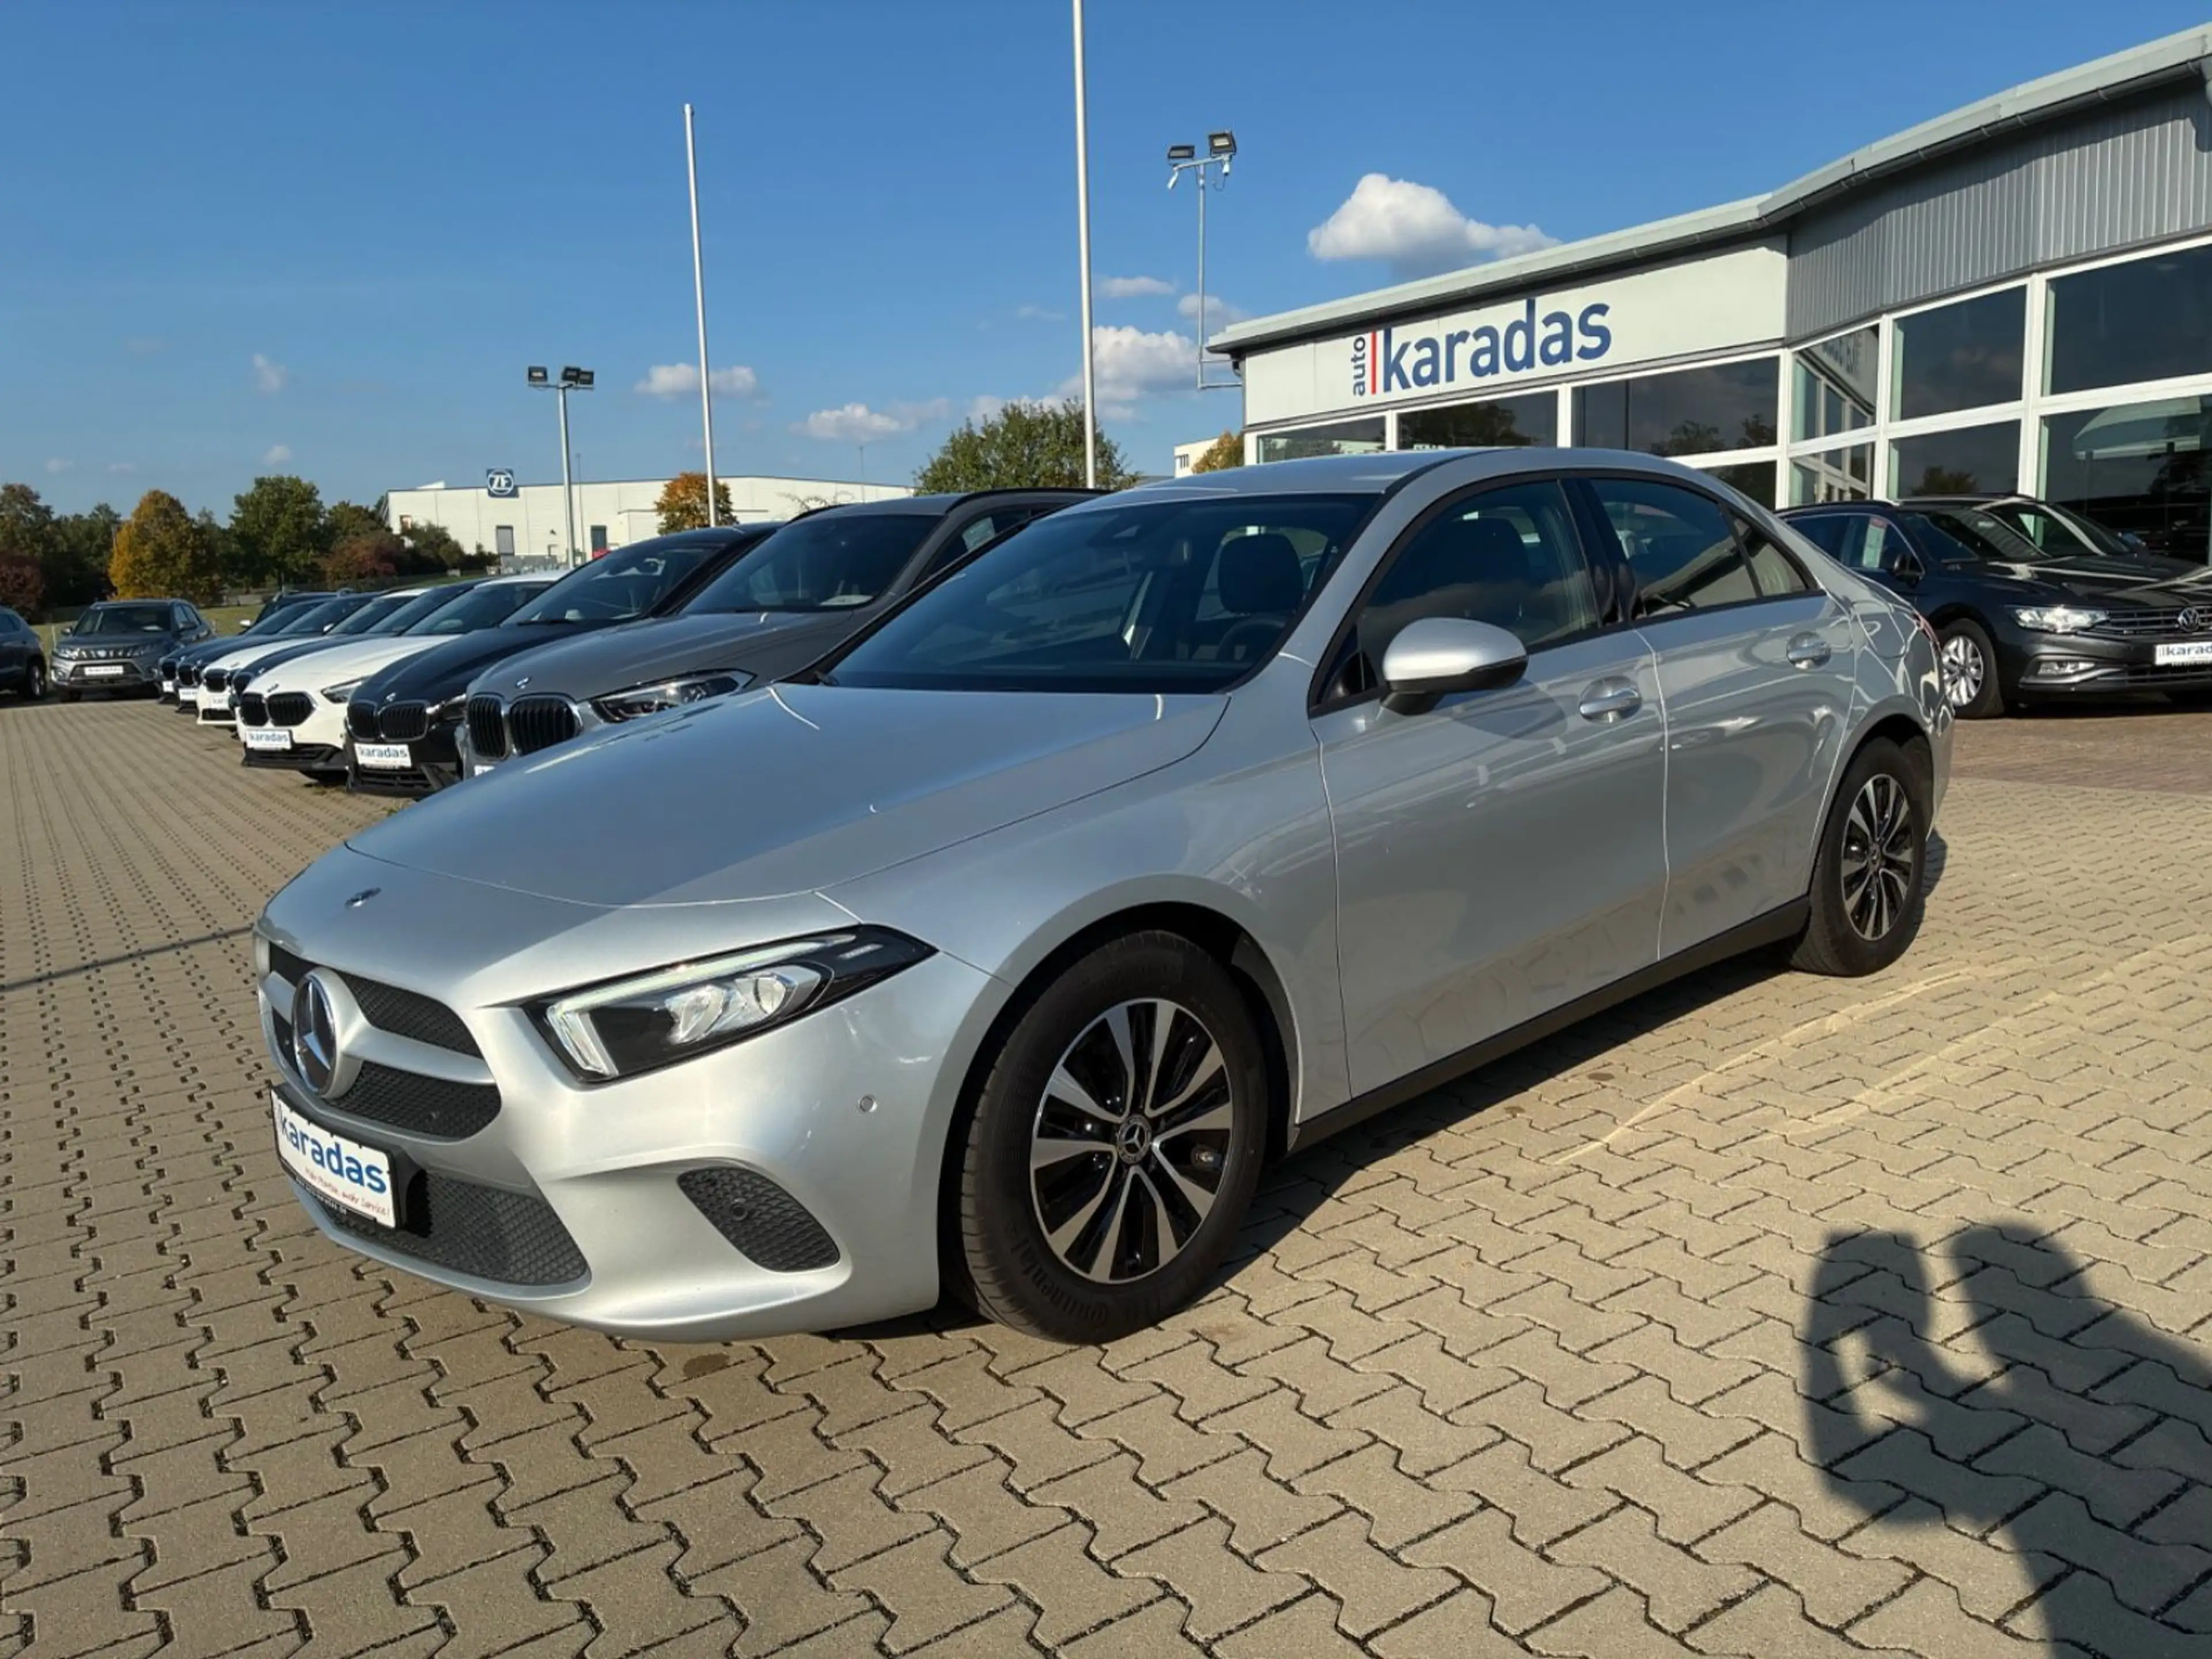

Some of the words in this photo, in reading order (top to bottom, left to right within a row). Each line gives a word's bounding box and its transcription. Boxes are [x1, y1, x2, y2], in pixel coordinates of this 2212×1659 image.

[1351, 336, 1365, 397] auto
[1383, 298, 1612, 393] karadas
[489, 472, 513, 491] ZF
[279, 1104, 387, 1194] karadas
